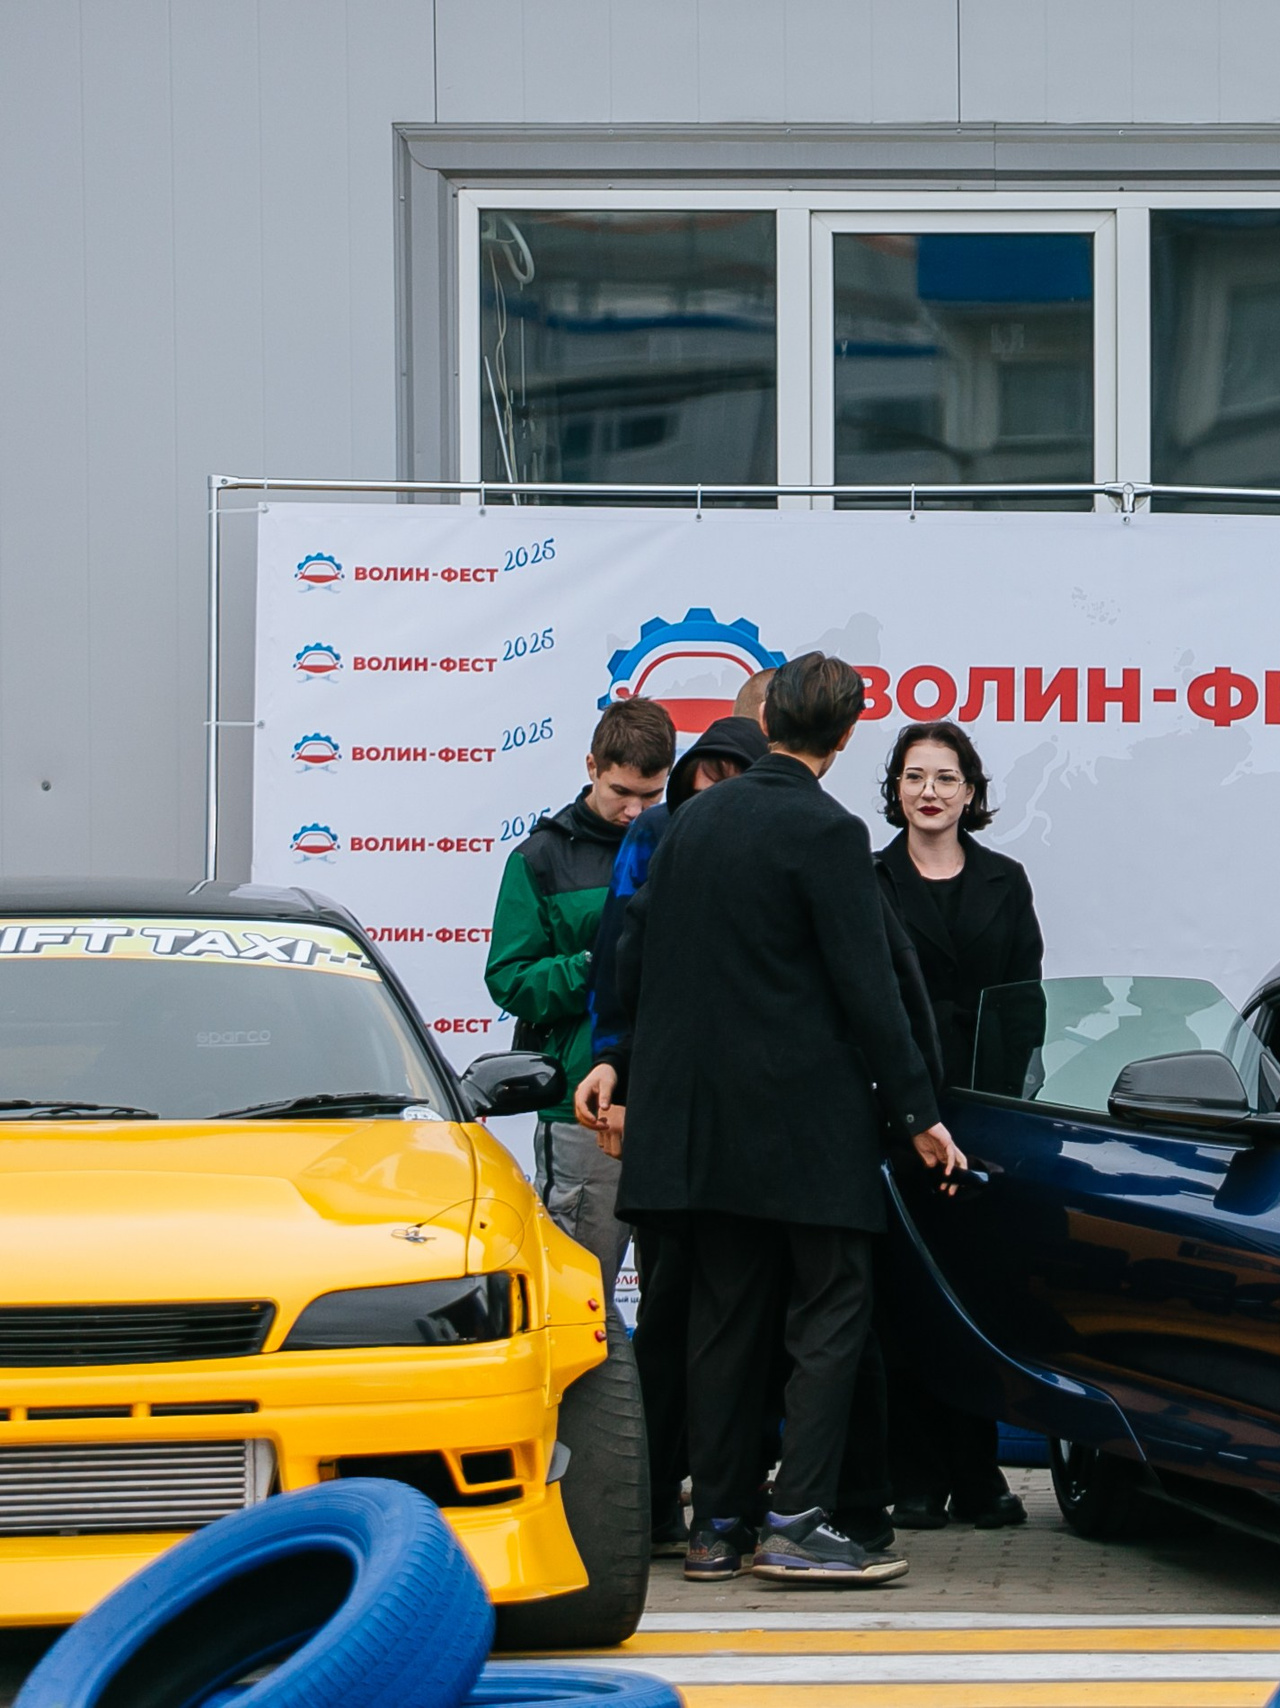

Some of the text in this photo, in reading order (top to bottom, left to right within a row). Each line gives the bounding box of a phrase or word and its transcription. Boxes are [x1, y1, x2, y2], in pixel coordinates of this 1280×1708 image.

[354, 537, 556, 583] ВОЛИН-ФЕСТ 2025
[353, 627, 555, 673] ВОЛИН-ФЕСТ 2025
[351, 717, 553, 763] ВОЛИН-ФЕСТ 2025
[350, 836, 495, 853] ВОЛИН-ФЕСТ
[0, 926, 317, 965] IFT TAXI
[365, 927, 492, 943] ОЛИН-ФЕСТ
[196, 1029, 271, 1046] sparco
